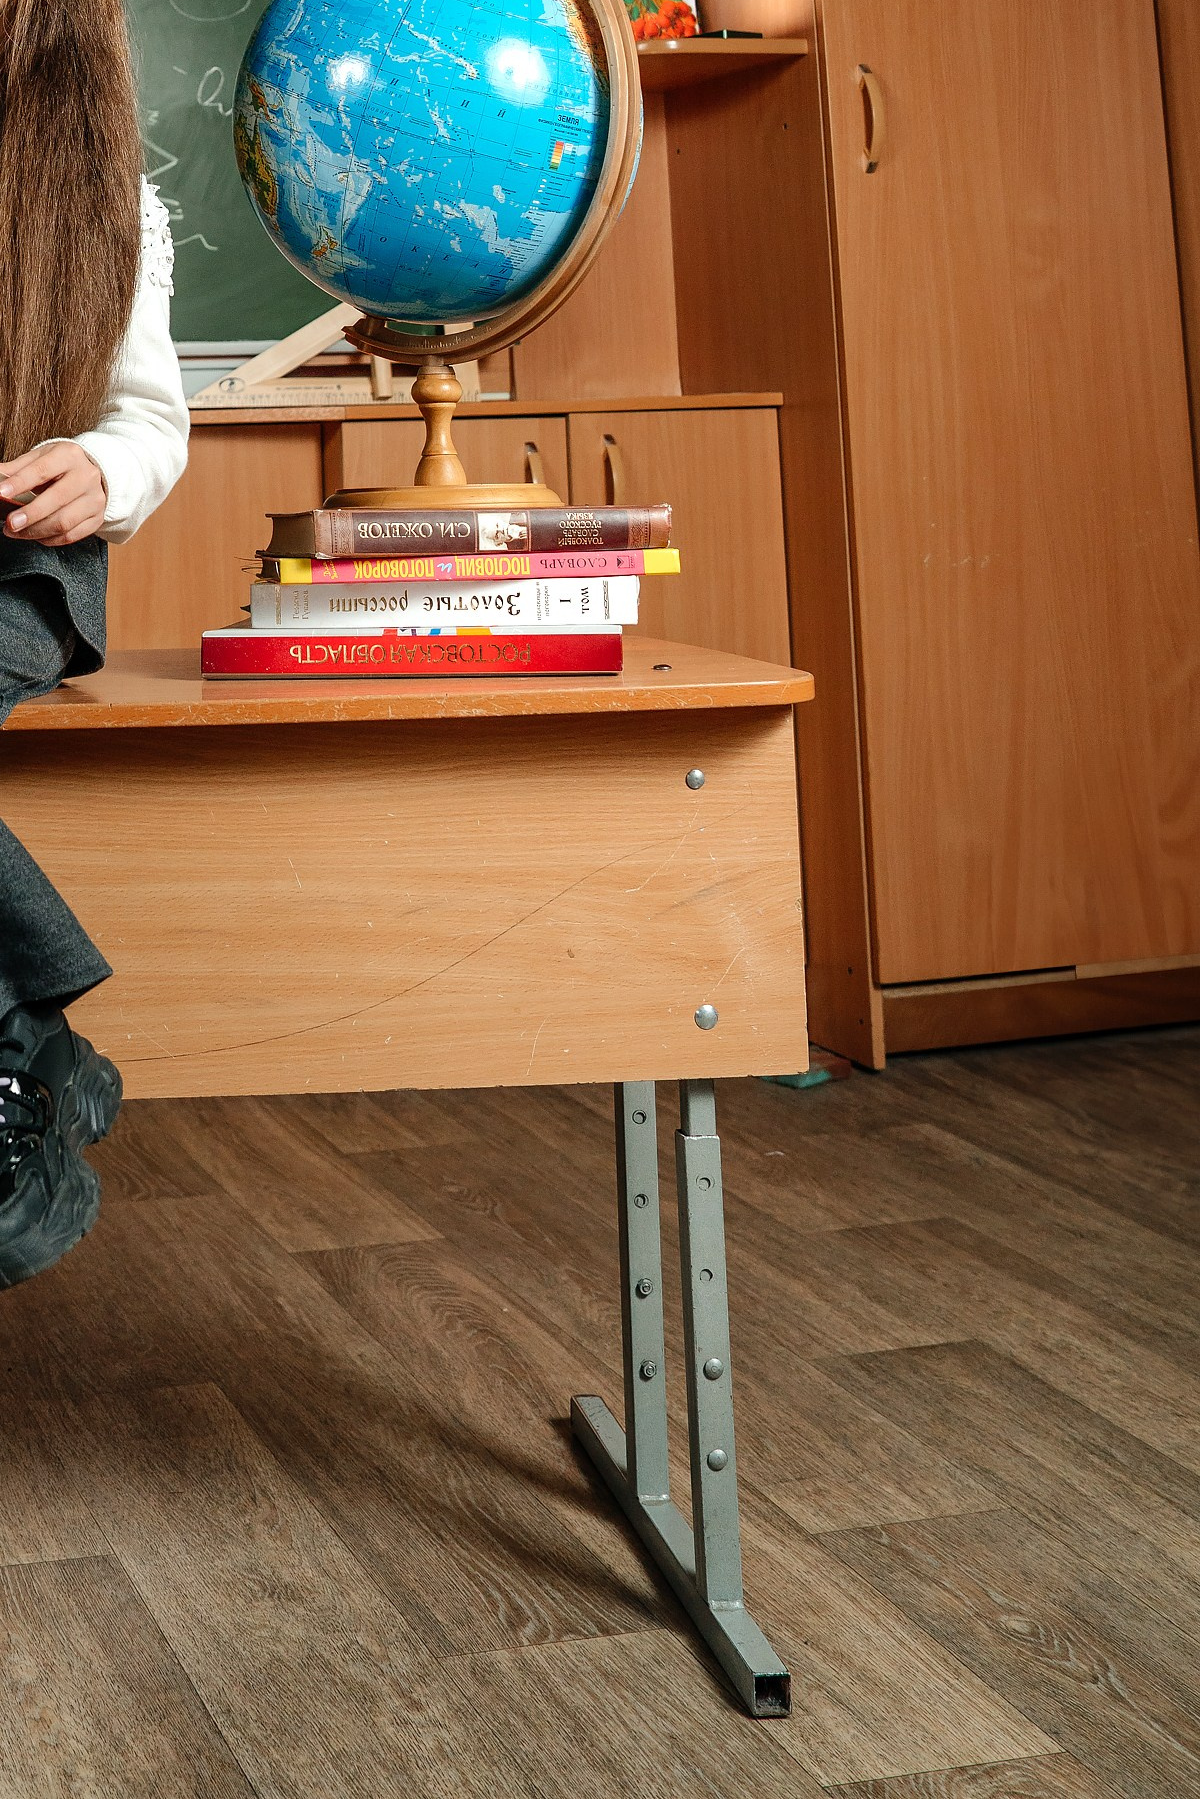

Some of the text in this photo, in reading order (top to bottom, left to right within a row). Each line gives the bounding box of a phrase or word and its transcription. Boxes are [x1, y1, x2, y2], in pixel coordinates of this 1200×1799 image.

[559, 520, 602, 529] РУССКОГО
[565, 512, 594, 521] ЯЗЫКА
[357, 522, 433, 539] ОЖЕГОВ
[562, 529, 600, 537] СЛОВАРЬ
[558, 537, 603, 546] ТОЛКОВЫЙ
[354, 558, 435, 579] ПОГОВОРОК
[455, 555, 531, 577] ПОСЛОВИЦ
[539, 557, 608, 569] СЛОВАРЬ
[329, 589, 408, 613] россыпи
[422, 592, 521, 616] Золотые
[289, 643, 531, 664] РОСТОВСКАЯ ОБЛАСТЬ
